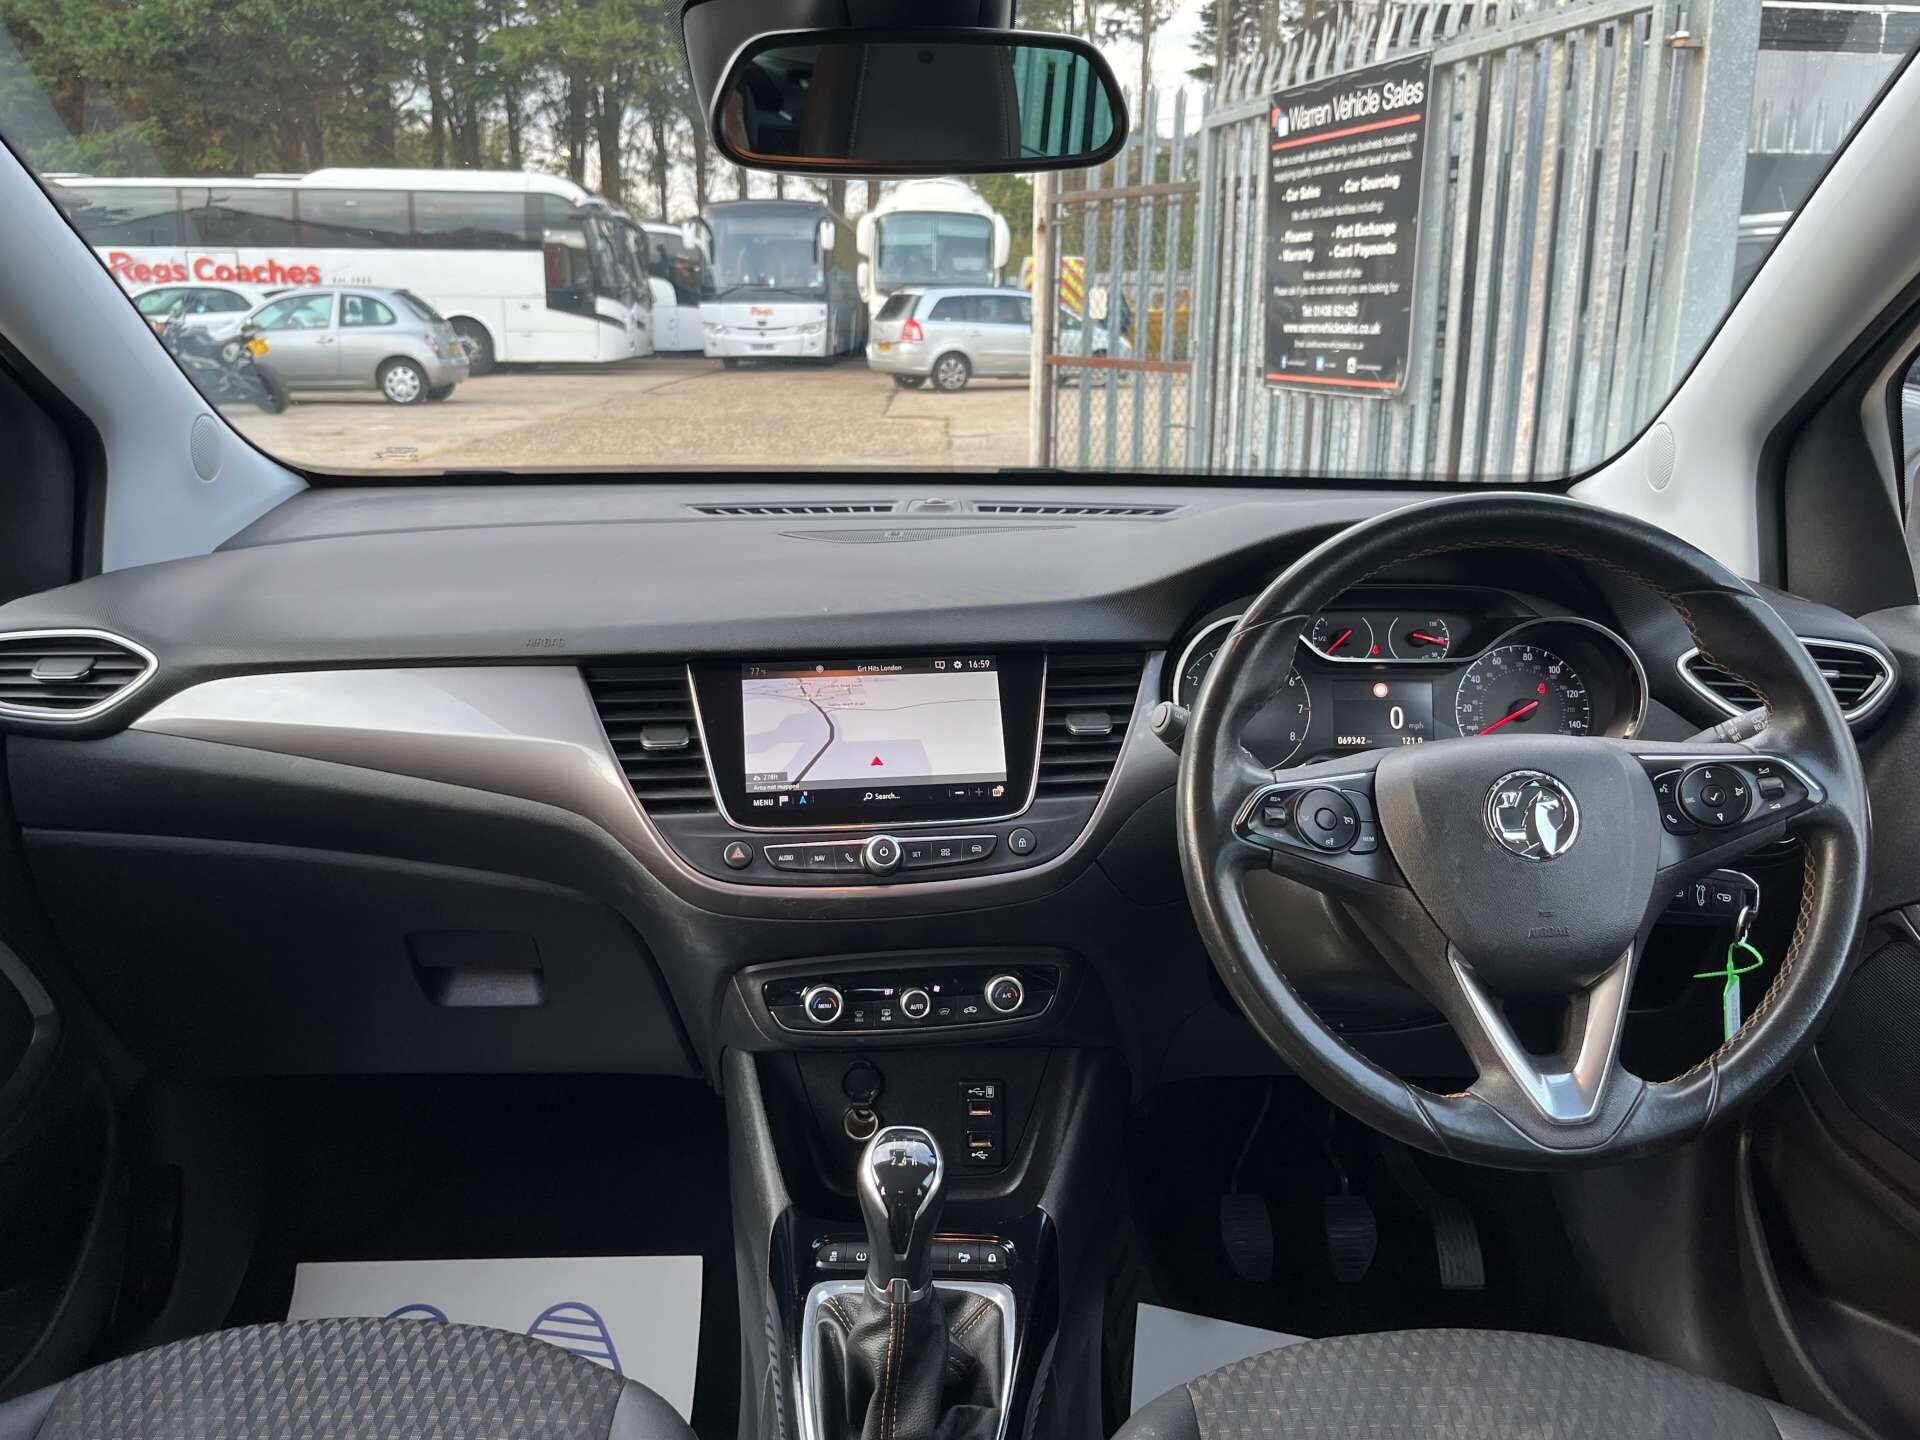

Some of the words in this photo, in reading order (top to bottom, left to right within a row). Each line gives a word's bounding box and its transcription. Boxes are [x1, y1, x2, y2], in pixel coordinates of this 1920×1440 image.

[1289, 102, 1332, 132] Warren
[1332, 87, 1380, 121] Vehicle
[1382, 78, 1424, 111] Sales
[1344, 178, 1360, 194] Car
[1360, 173, 1400, 191] Sourcing
[1285, 187, 1299, 202] Car
[1300, 185, 1321, 200] Sales
[1335, 224, 1354, 239] Part
[1354, 222, 1397, 238] Exchange
[1284, 230, 1313, 243] Finance
[1333, 244, 1353, 258] Card
[1353, 242, 1398, 259] Payments
[193, 255, 322, 285] Coaches
[1492, 657, 1502, 665] 60
[1522, 652, 1533, 661] 80
[868, 664, 880, 672] Hits
[880, 663, 902, 672] London
[968, 660, 990, 669] 16:59
[1548, 665, 1561, 674] 100
[1192, 677, 1199, 686] 2
[1288, 677, 1295, 687] 6
[1470, 675, 1480, 683] 40
[1566, 690, 1579, 698] 120
[1297, 704, 1303, 714] 7
[1462, 704, 1472, 713] 20
[1389, 706, 1404, 730] 0
[1408, 722, 1424, 732] mph
[1568, 720, 1581, 729] 140
[1289, 731, 1296, 741] 8
[1337, 736, 1366, 745] 069342
[1402, 736, 1423, 745] 121.0
[753, 798, 774, 807] MENU
[778, 854, 794, 862] AUDIO
[909, 1003, 924, 1011] AUTO
